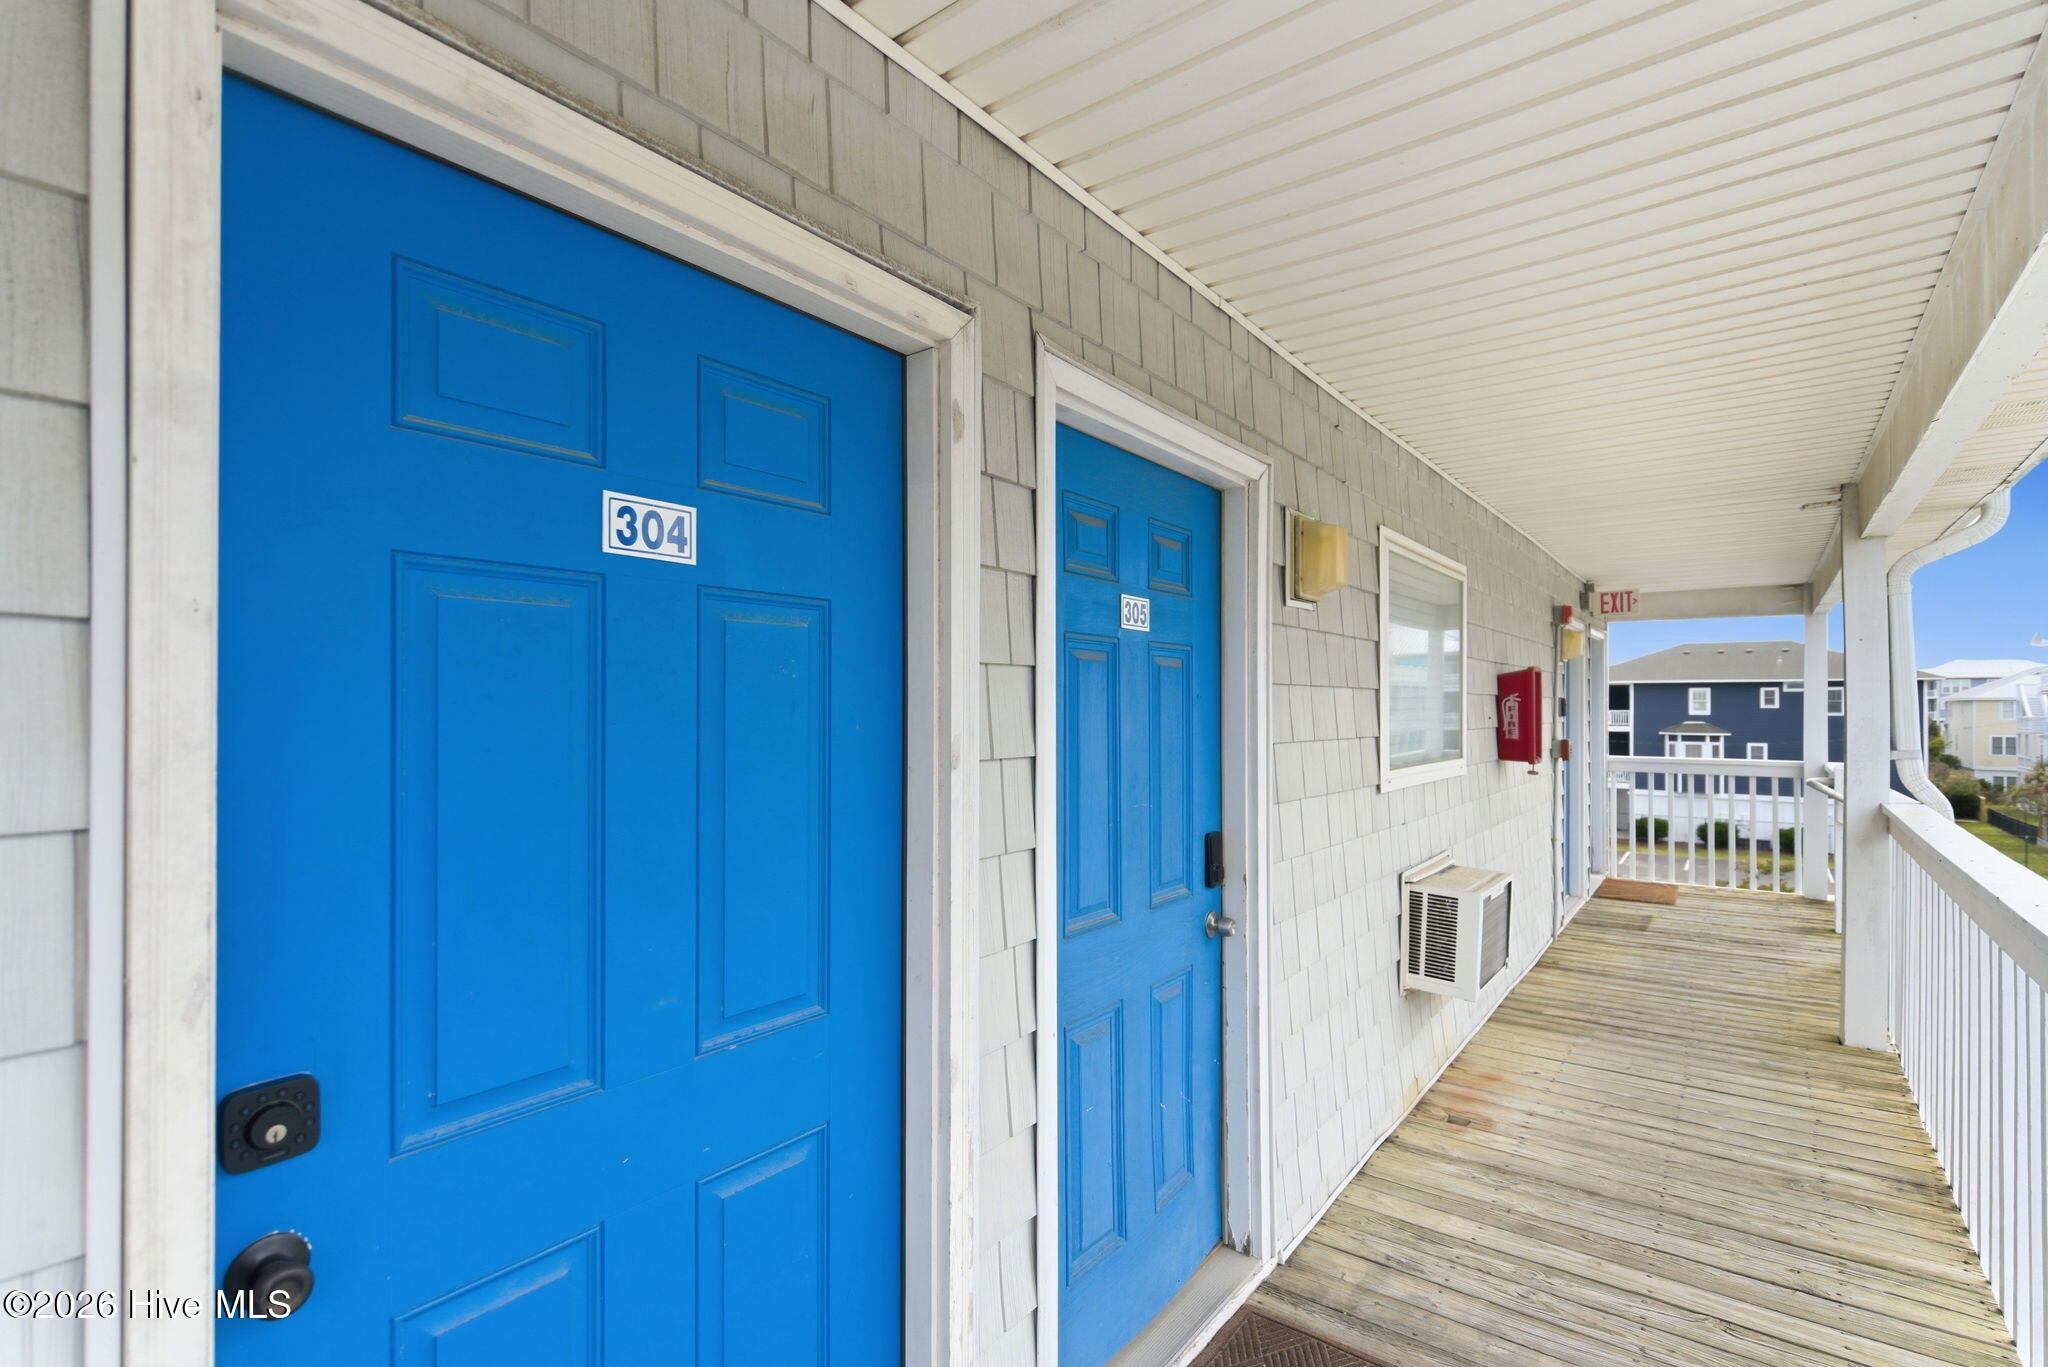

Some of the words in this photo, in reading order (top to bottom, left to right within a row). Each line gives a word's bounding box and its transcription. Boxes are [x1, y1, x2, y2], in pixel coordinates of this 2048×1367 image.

[617, 505, 688, 554] 304
[1125, 601, 1147, 625] 305
[1600, 591, 1632, 614] EXIT
